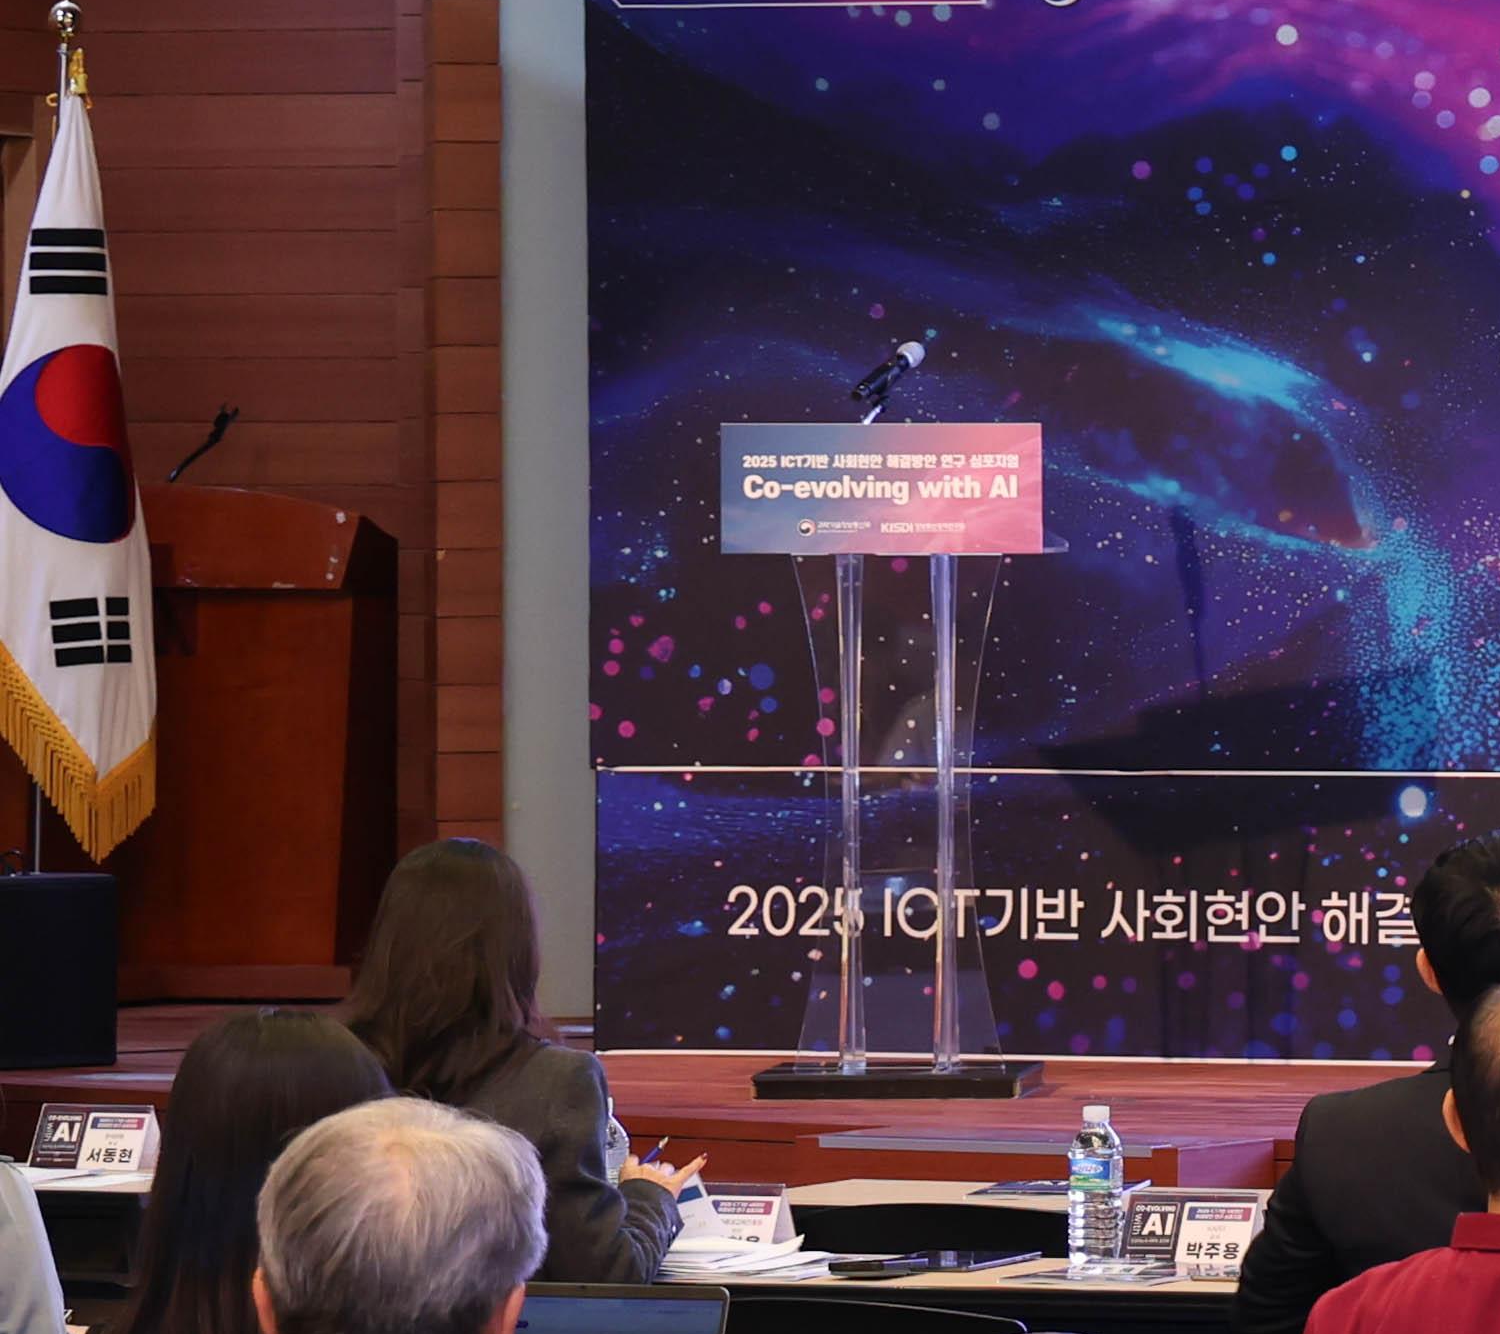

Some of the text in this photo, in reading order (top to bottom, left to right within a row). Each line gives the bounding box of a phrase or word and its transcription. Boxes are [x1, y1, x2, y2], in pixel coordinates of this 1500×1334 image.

[742, 454, 777, 468] 2025
[780, 454, 828, 468] ICT기반
[743, 474, 1018, 505] Co-evolving with AI
[727, 885, 866, 938] 2025
[1100, 887, 1304, 945] 사회현안
[52, 1121, 81, 1143] AI
[86, 1147, 133, 1164] 서동현
[1141, 1213, 1174, 1236] AI
[1186, 1242, 1240, 1260] 박주용
